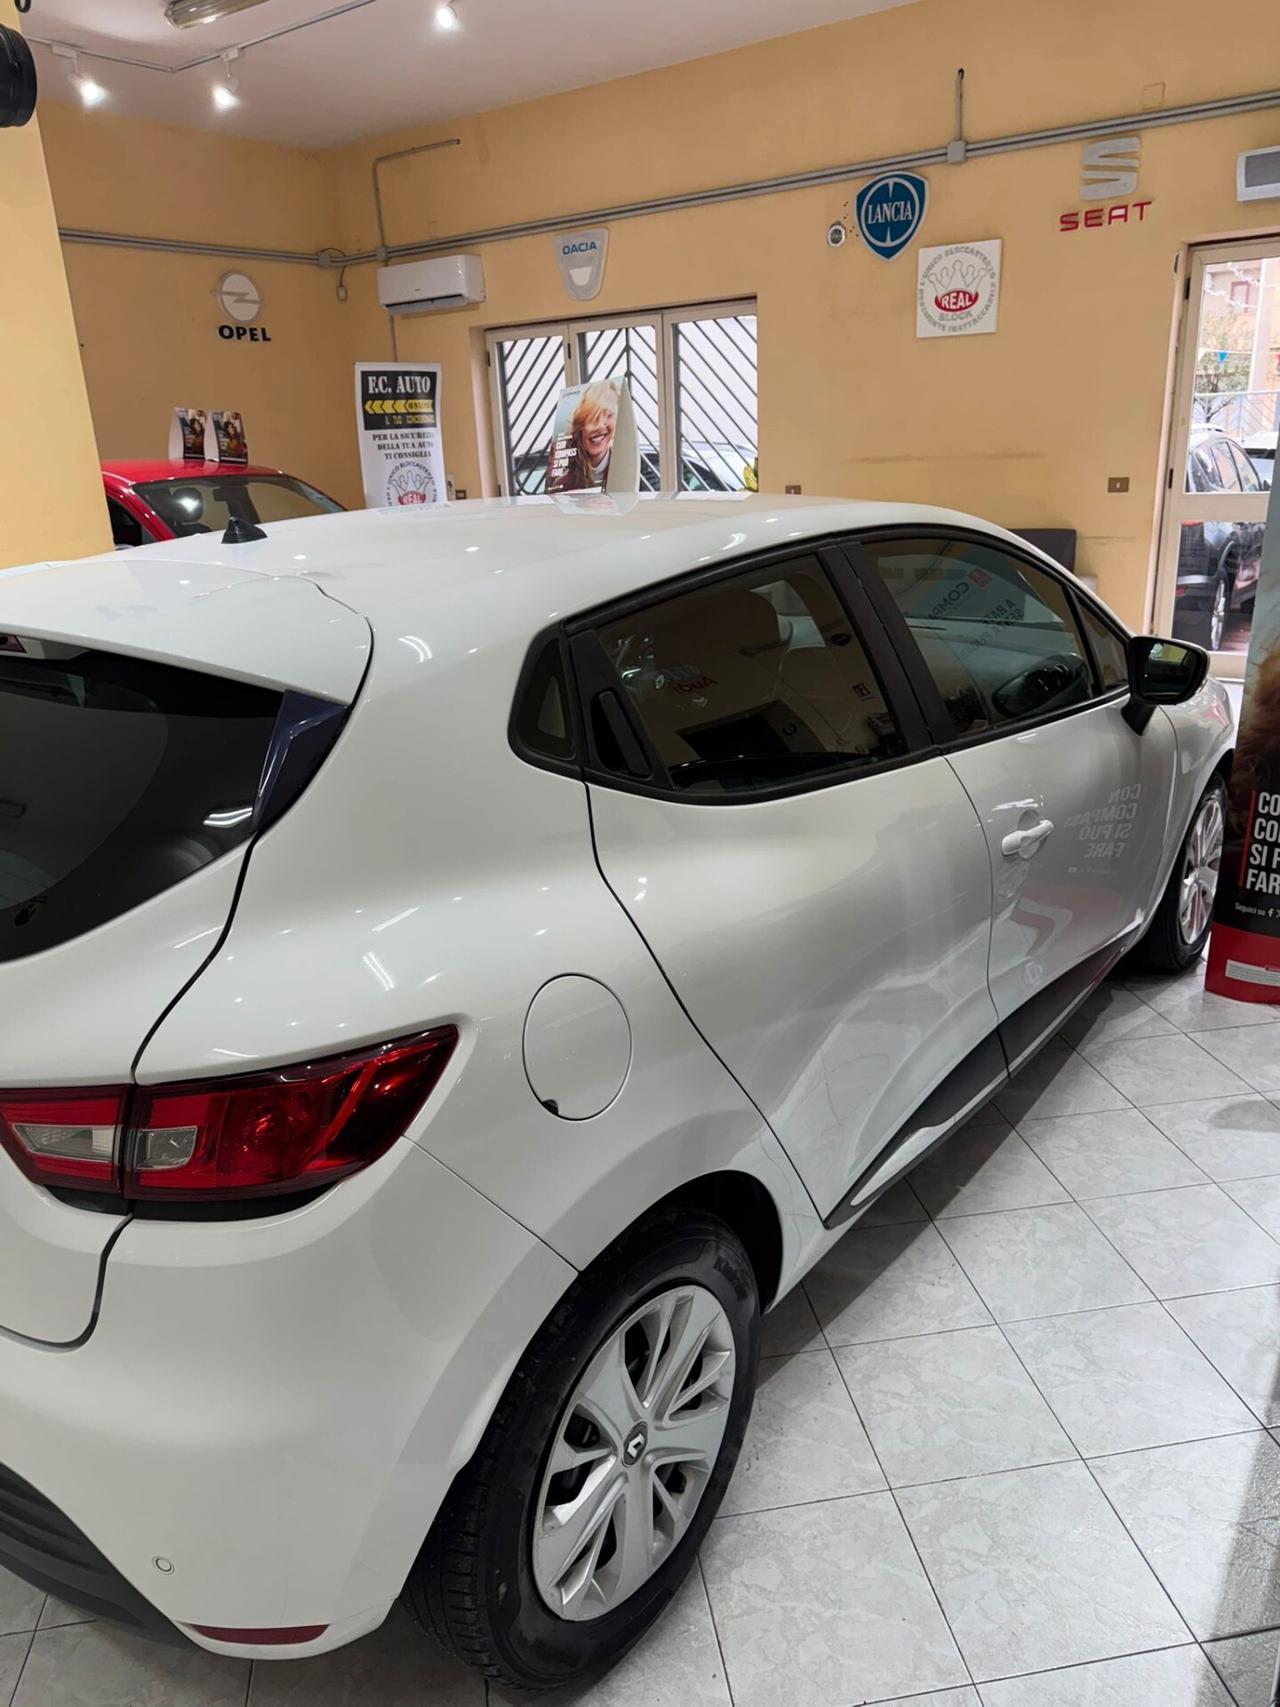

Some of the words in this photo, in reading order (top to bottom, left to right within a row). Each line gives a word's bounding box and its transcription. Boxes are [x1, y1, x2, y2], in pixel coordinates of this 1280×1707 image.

[867, 200, 912, 224] LANCIA
[1060, 201, 1152, 232] SEAT
[562, 241, 597, 255] DACIA
[941, 292, 972, 310] REAL
[939, 310, 973, 321] BLOCK
[218, 325, 271, 342] OPEL
[368, 376, 392, 393] F.C.
[396, 376, 431, 393] AUTO
[372, 433, 389, 441] PER
[390, 432, 399, 440] LA
[378, 442, 400, 450] DELLA
[393, 450, 431, 459] CONSIGLIA
[1253, 817, 1280, 845] CO
[1249, 843, 1266, 868] SI
